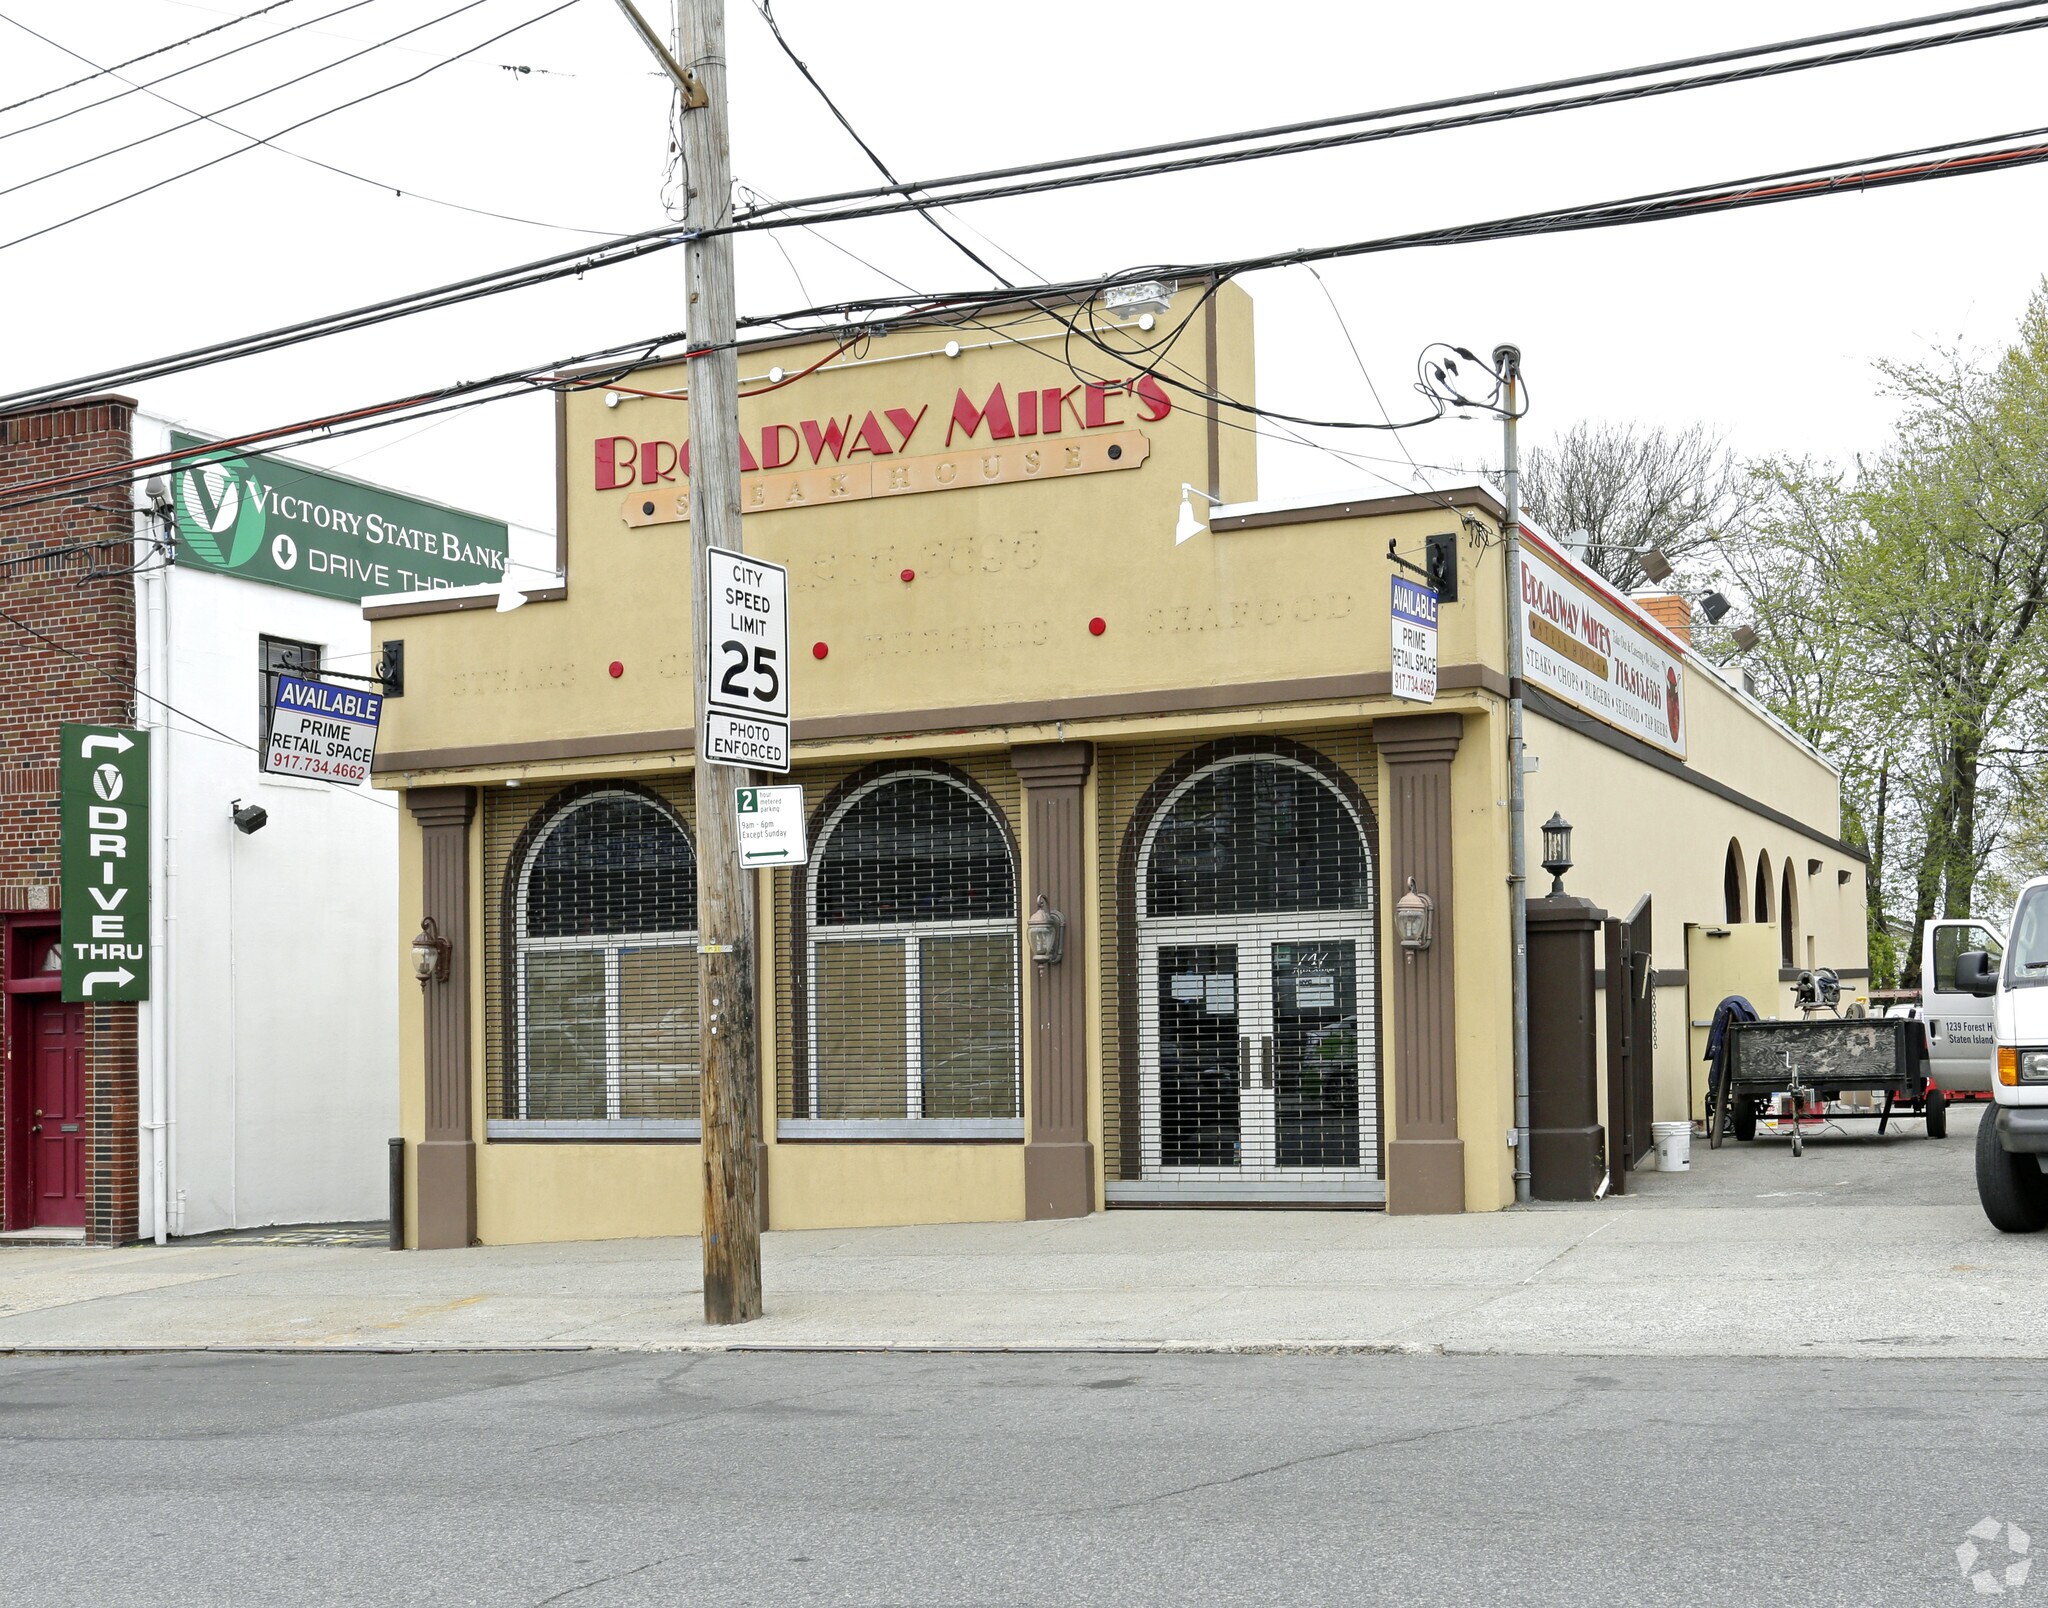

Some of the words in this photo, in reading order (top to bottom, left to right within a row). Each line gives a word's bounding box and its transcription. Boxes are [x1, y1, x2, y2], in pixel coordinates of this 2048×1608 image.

[945, 374, 1172, 447] MIKE'S
[245, 479, 362, 535] VICTORY
[366, 513, 439, 555] STATE
[442, 532, 504, 571] BANK
[309, 549, 389, 587] DRIVE
[733, 565, 763, 587] CITY
[725, 587, 770, 613] SPEED
[1393, 585, 1436, 622] AVAILABLE
[731, 613, 766, 636] LIMIT
[1403, 627, 1426, 651] PRIME
[721, 640, 779, 702] 25
[1393, 647, 1414, 671] RETAIL
[1415, 654, 1436, 676] SPACE
[1394, 672, 1435, 696] 917.734.4662
[1526, 646, 1551, 677] STEAKS
[1558, 665, 1579, 691] CHOPS
[1615, 697, 1640, 723] SEAFOOD
[281, 683, 378, 721] AVAILABLE
[300, 719, 351, 741] PRIME
[730, 722, 770, 741] PHOTO
[272, 733, 321, 755] RETAIL
[326, 742, 372, 763] SPACE
[714, 738, 781, 761] ENFORCED
[273, 753, 365, 780] 917.734.4662
[742, 790, 753, 812] 2
[742, 821, 755, 829] 9am
[761, 820, 775, 829] 6pm
[742, 830, 763, 839] Except
[765, 829, 787, 838] Sunday
[88, 806, 128, 938] DRIVE
[73, 944, 143, 960] THRU
[1946, 1022, 1961, 1031] 1239
[1964, 1022, 1985, 1031] Forest
[1949, 1034, 1971, 1044] Staten
[1973, 1035, 1994, 1044] Island
